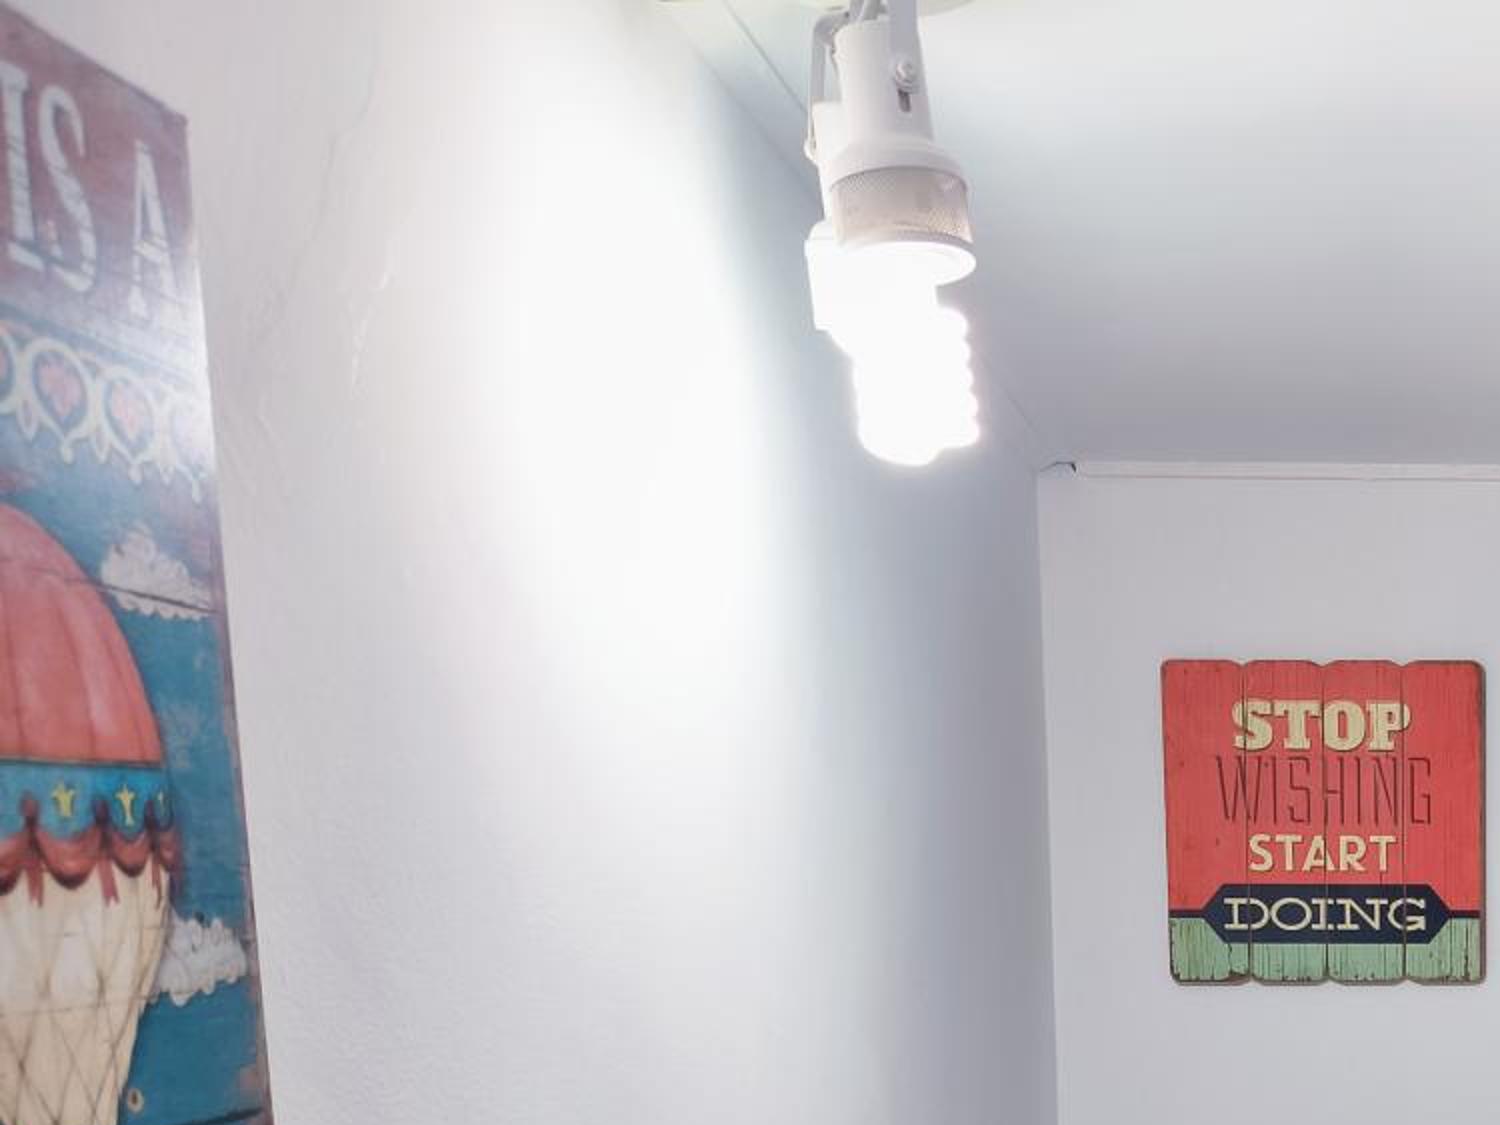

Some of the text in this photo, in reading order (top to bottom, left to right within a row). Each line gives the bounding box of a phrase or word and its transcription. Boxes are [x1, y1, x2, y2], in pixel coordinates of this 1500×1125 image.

[0, 60, 186, 318] IS A
[1232, 699, 1411, 752] STOP
[1215, 755, 1431, 826] WISHING
[1249, 834, 1398, 874] START
[1223, 897, 1426, 932] DOING
